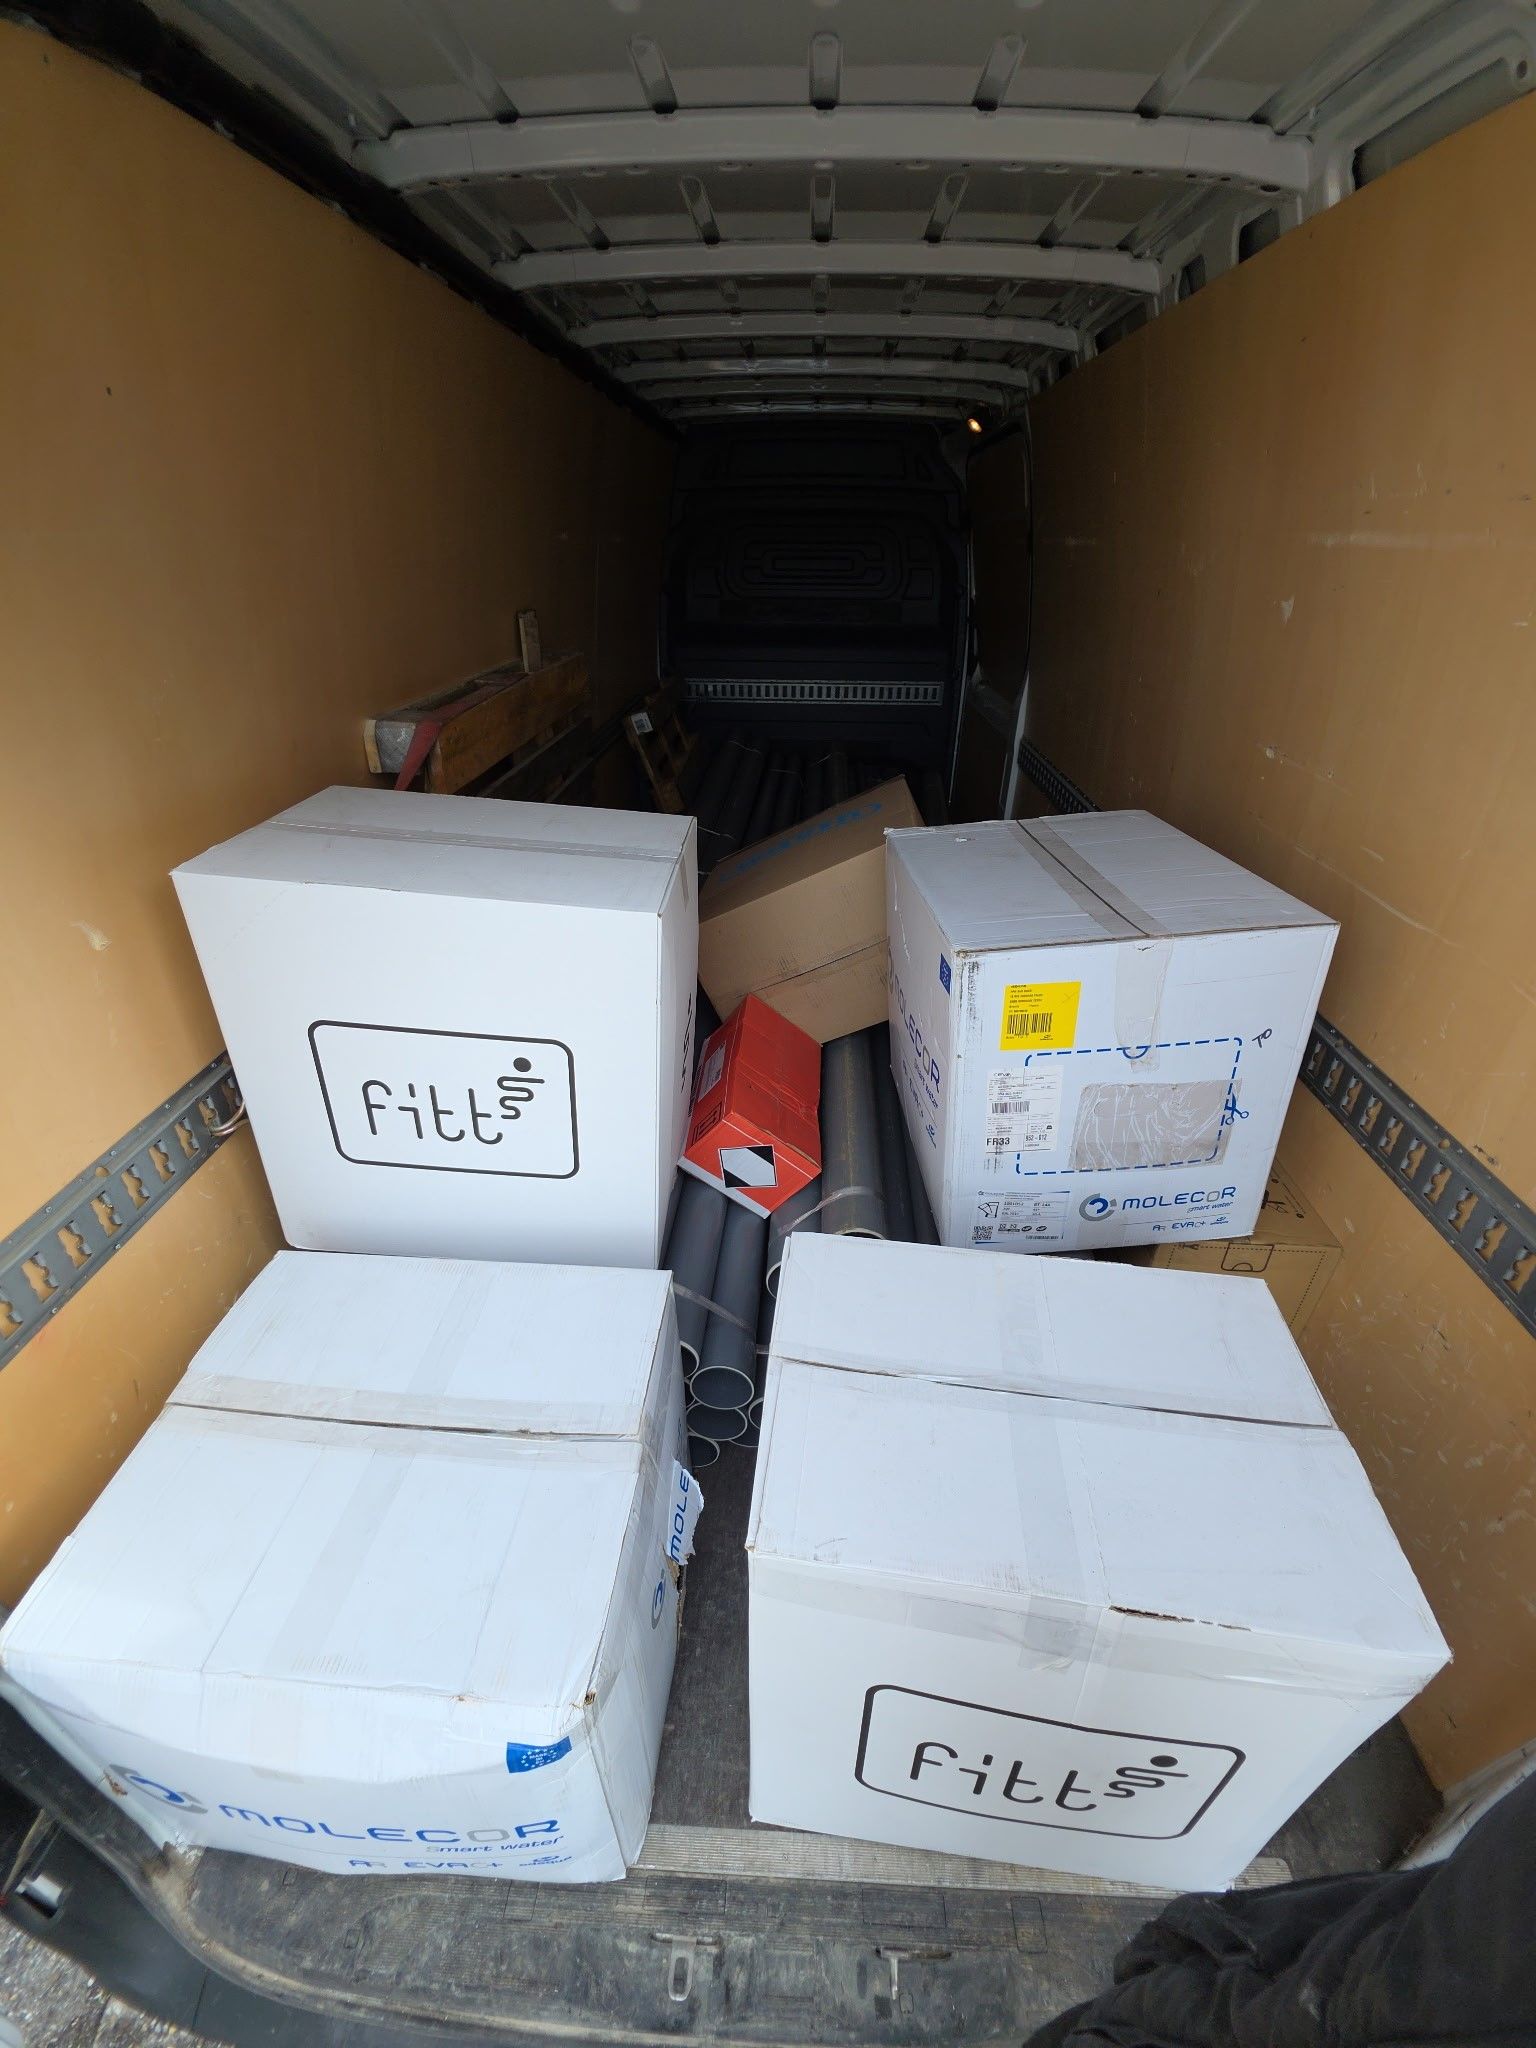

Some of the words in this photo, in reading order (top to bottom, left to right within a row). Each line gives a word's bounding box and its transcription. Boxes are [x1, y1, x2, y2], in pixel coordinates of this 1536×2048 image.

[986, 1137, 1011, 1146] FR33
[1121, 1186, 1237, 1211] MOLECOR
[671, 1471, 690, 1563] MOLE
[218, 1804, 560, 1843] MOLECOR
[500, 1836, 565, 1851] water
